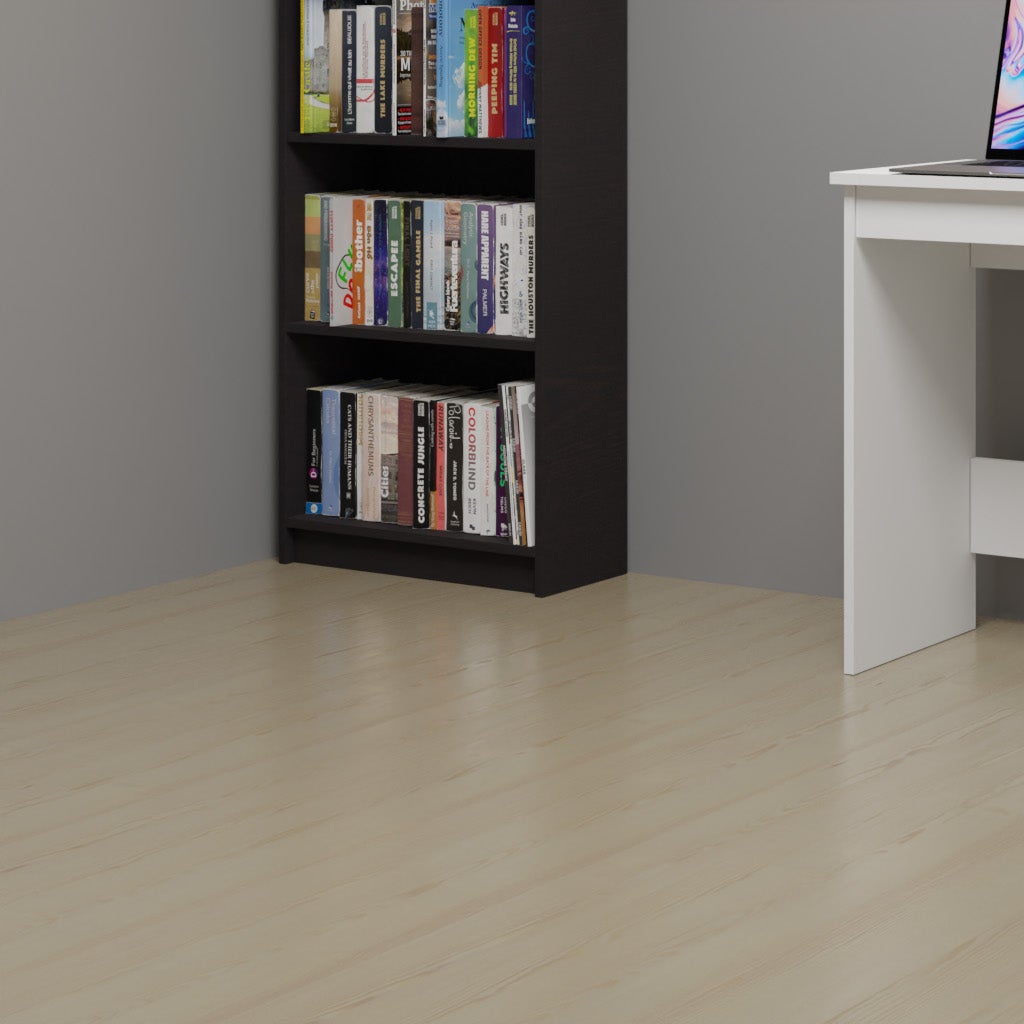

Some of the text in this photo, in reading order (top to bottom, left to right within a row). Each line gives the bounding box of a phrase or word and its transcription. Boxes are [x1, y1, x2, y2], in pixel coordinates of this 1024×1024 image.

[468, 37, 476, 118] MORNING DEW
[390, 240, 399, 297] ESCAPEE
[481, 211, 489, 281] HARE APPARENT
[500, 243, 509, 314] HIGHWAYS
[381, 465, 389, 498] Cities
[417, 426, 425, 524] CONCRETE JUNGLE
[468, 407, 476, 491] COLORBLIND
